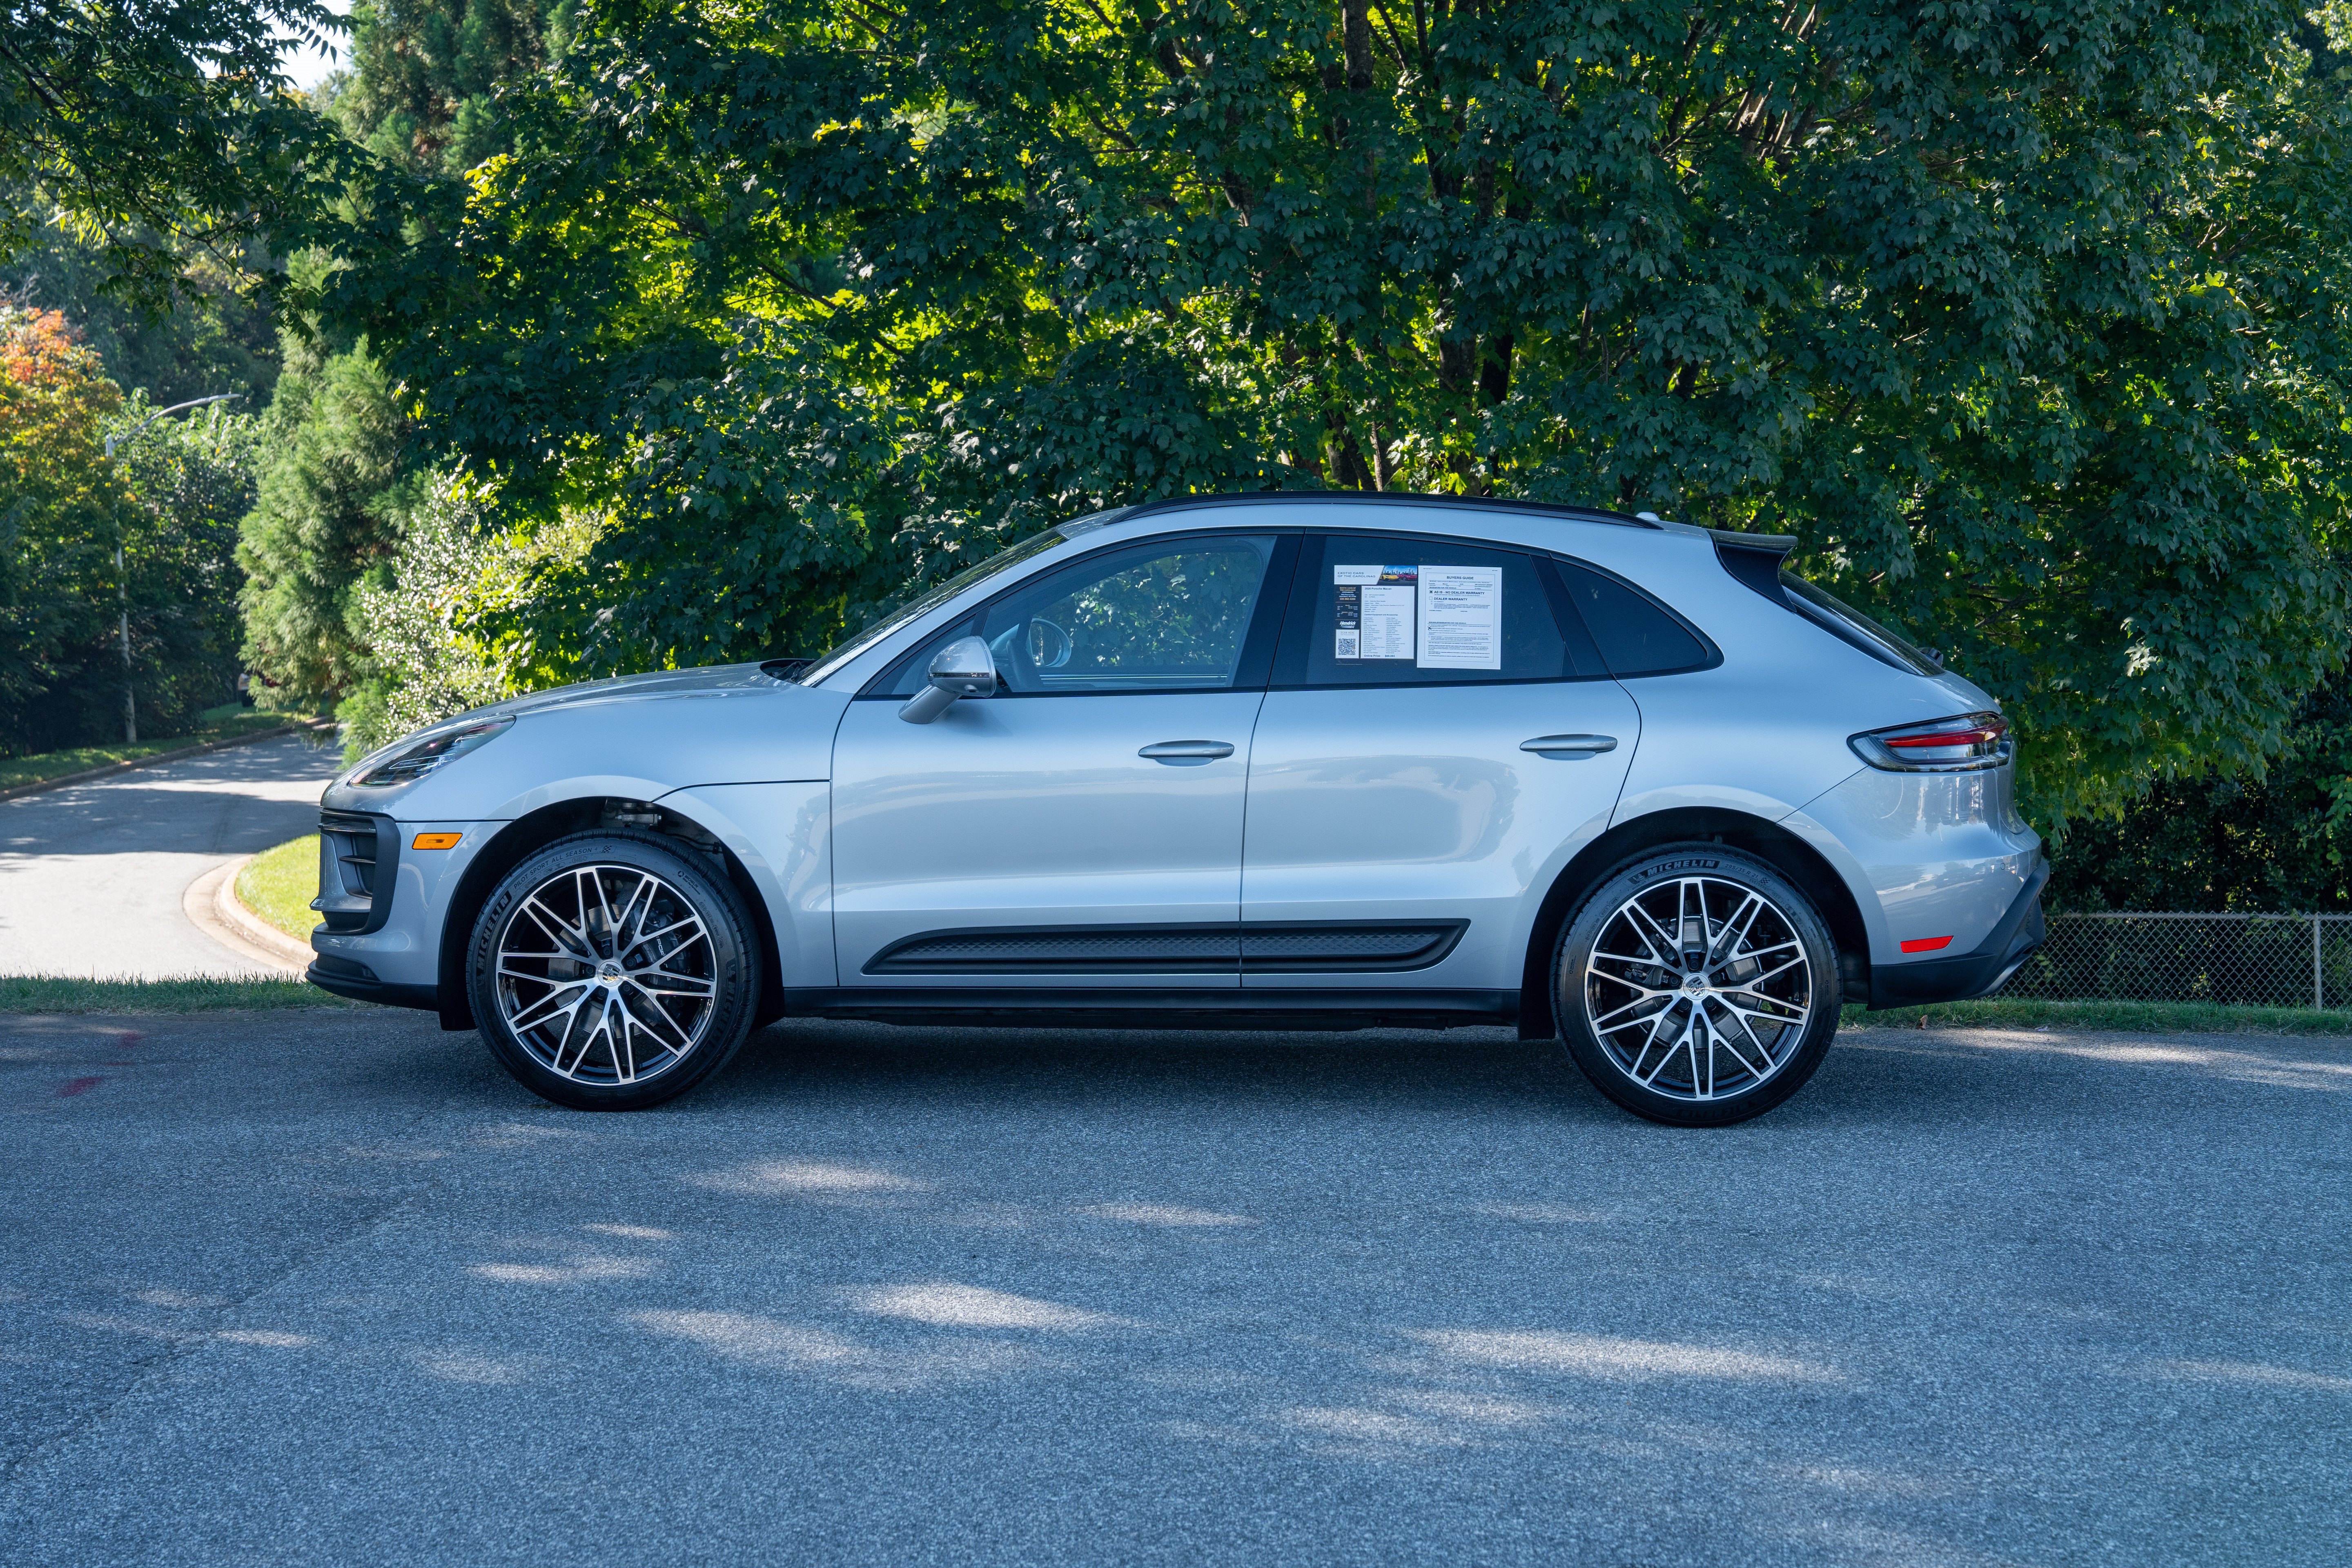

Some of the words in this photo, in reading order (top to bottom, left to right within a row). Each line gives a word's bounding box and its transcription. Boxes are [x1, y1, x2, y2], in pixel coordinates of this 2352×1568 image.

[514, 874, 528, 889] PILOT
[530, 860, 549, 875] SPORT
[552, 855, 563, 863] ALL
[565, 848, 592, 858] SEASON
[1648, 860, 1715, 876] MICHELIN
[1725, 864, 1745, 873] 295/35
[684, 875, 698, 888] MICHELIN
[477, 896, 511, 971] MICHELIN
